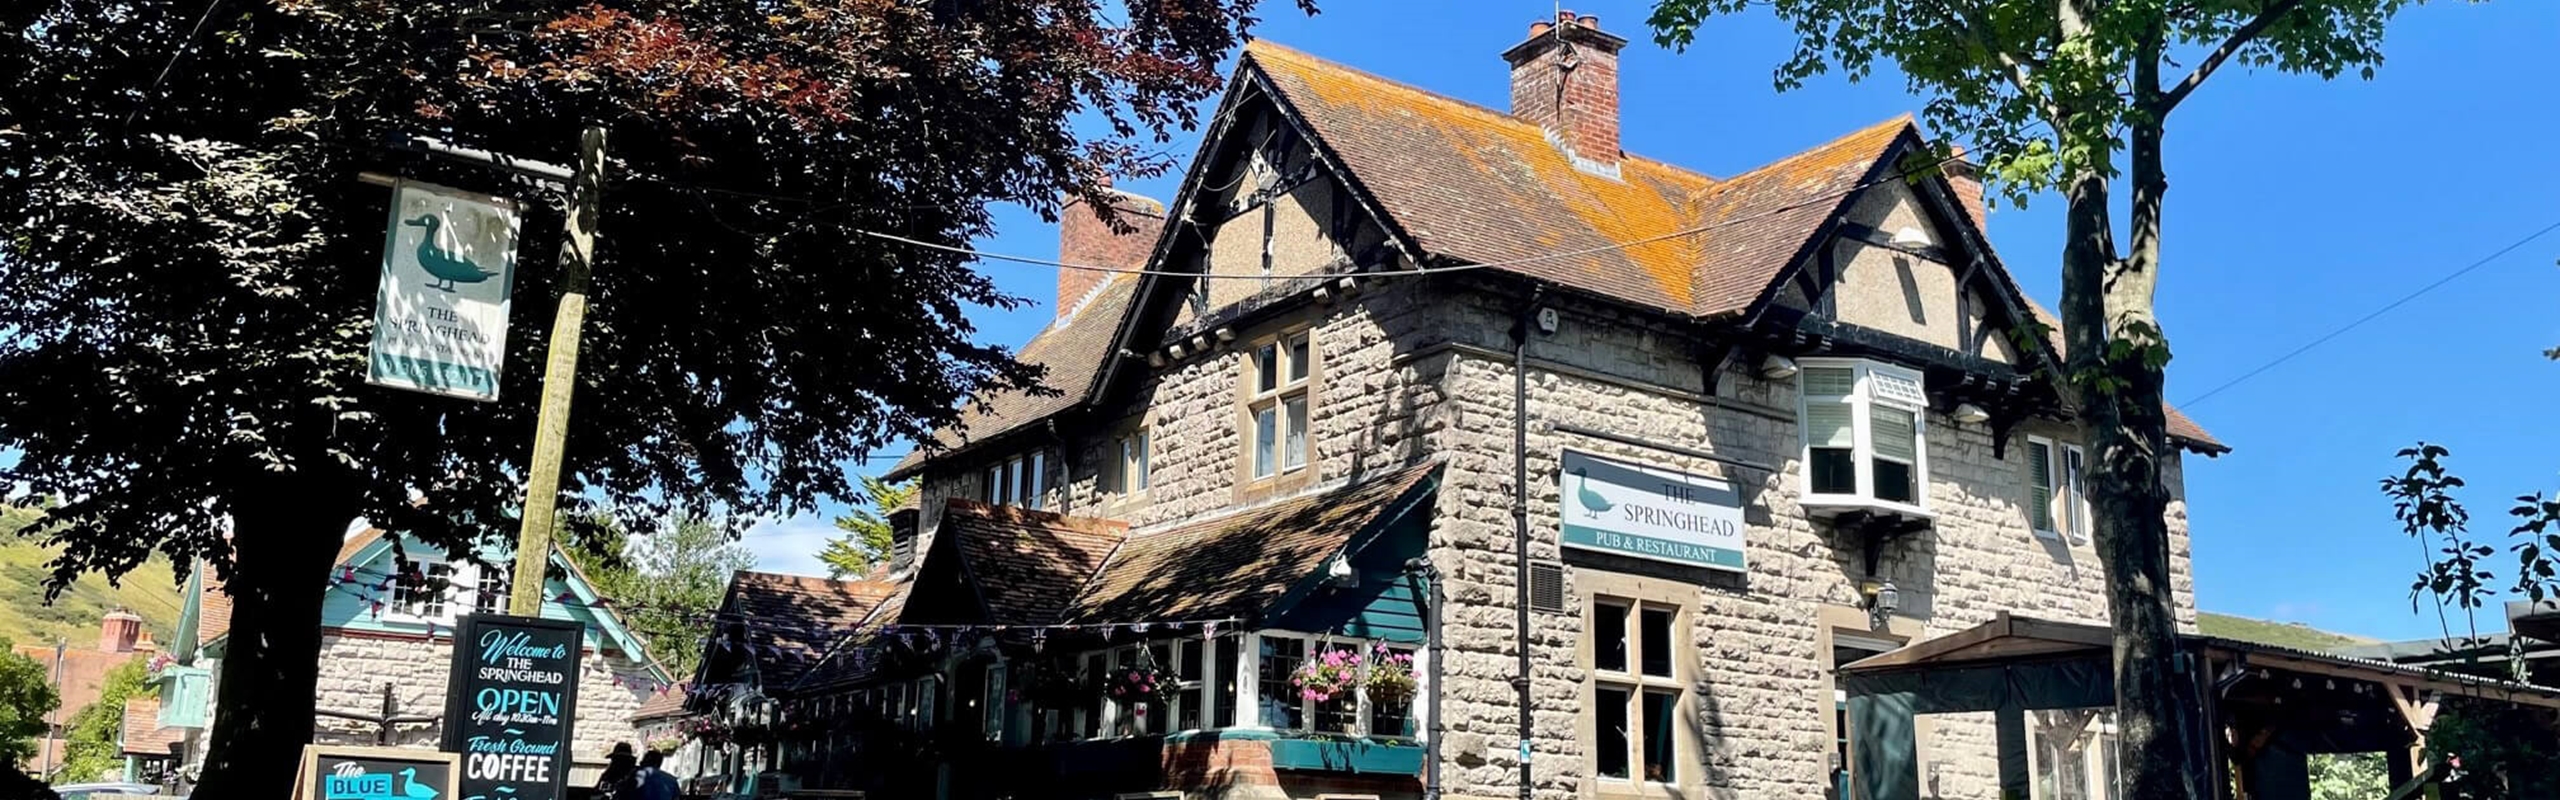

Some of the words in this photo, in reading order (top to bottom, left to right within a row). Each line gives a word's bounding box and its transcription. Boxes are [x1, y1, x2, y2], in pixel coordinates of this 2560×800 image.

[427, 306, 459, 323] THE
[388, 316, 491, 345] SPRINGHEAD
[1662, 483, 1696, 506] THE
[1624, 503, 1734, 538] SPRINGHEAD
[1596, 531, 1621, 548] PUB
[1623, 536, 1634, 550] &
[1636, 538, 1717, 562] RESTAURANT
[480, 629, 551, 665] Welcome
[552, 643, 566, 659] to
[507, 656, 533, 670] THE
[478, 666, 564, 684] SPRINGHEAD
[477, 687, 560, 716] OPEN
[472, 703, 492, 725] All
[493, 710, 510, 725] day
[468, 735, 507, 753] Fresh
[510, 738, 559, 755] Ground
[332, 761, 366, 778] The
[467, 752, 552, 782] COFFEE
[333, 779, 386, 794] BLUE
